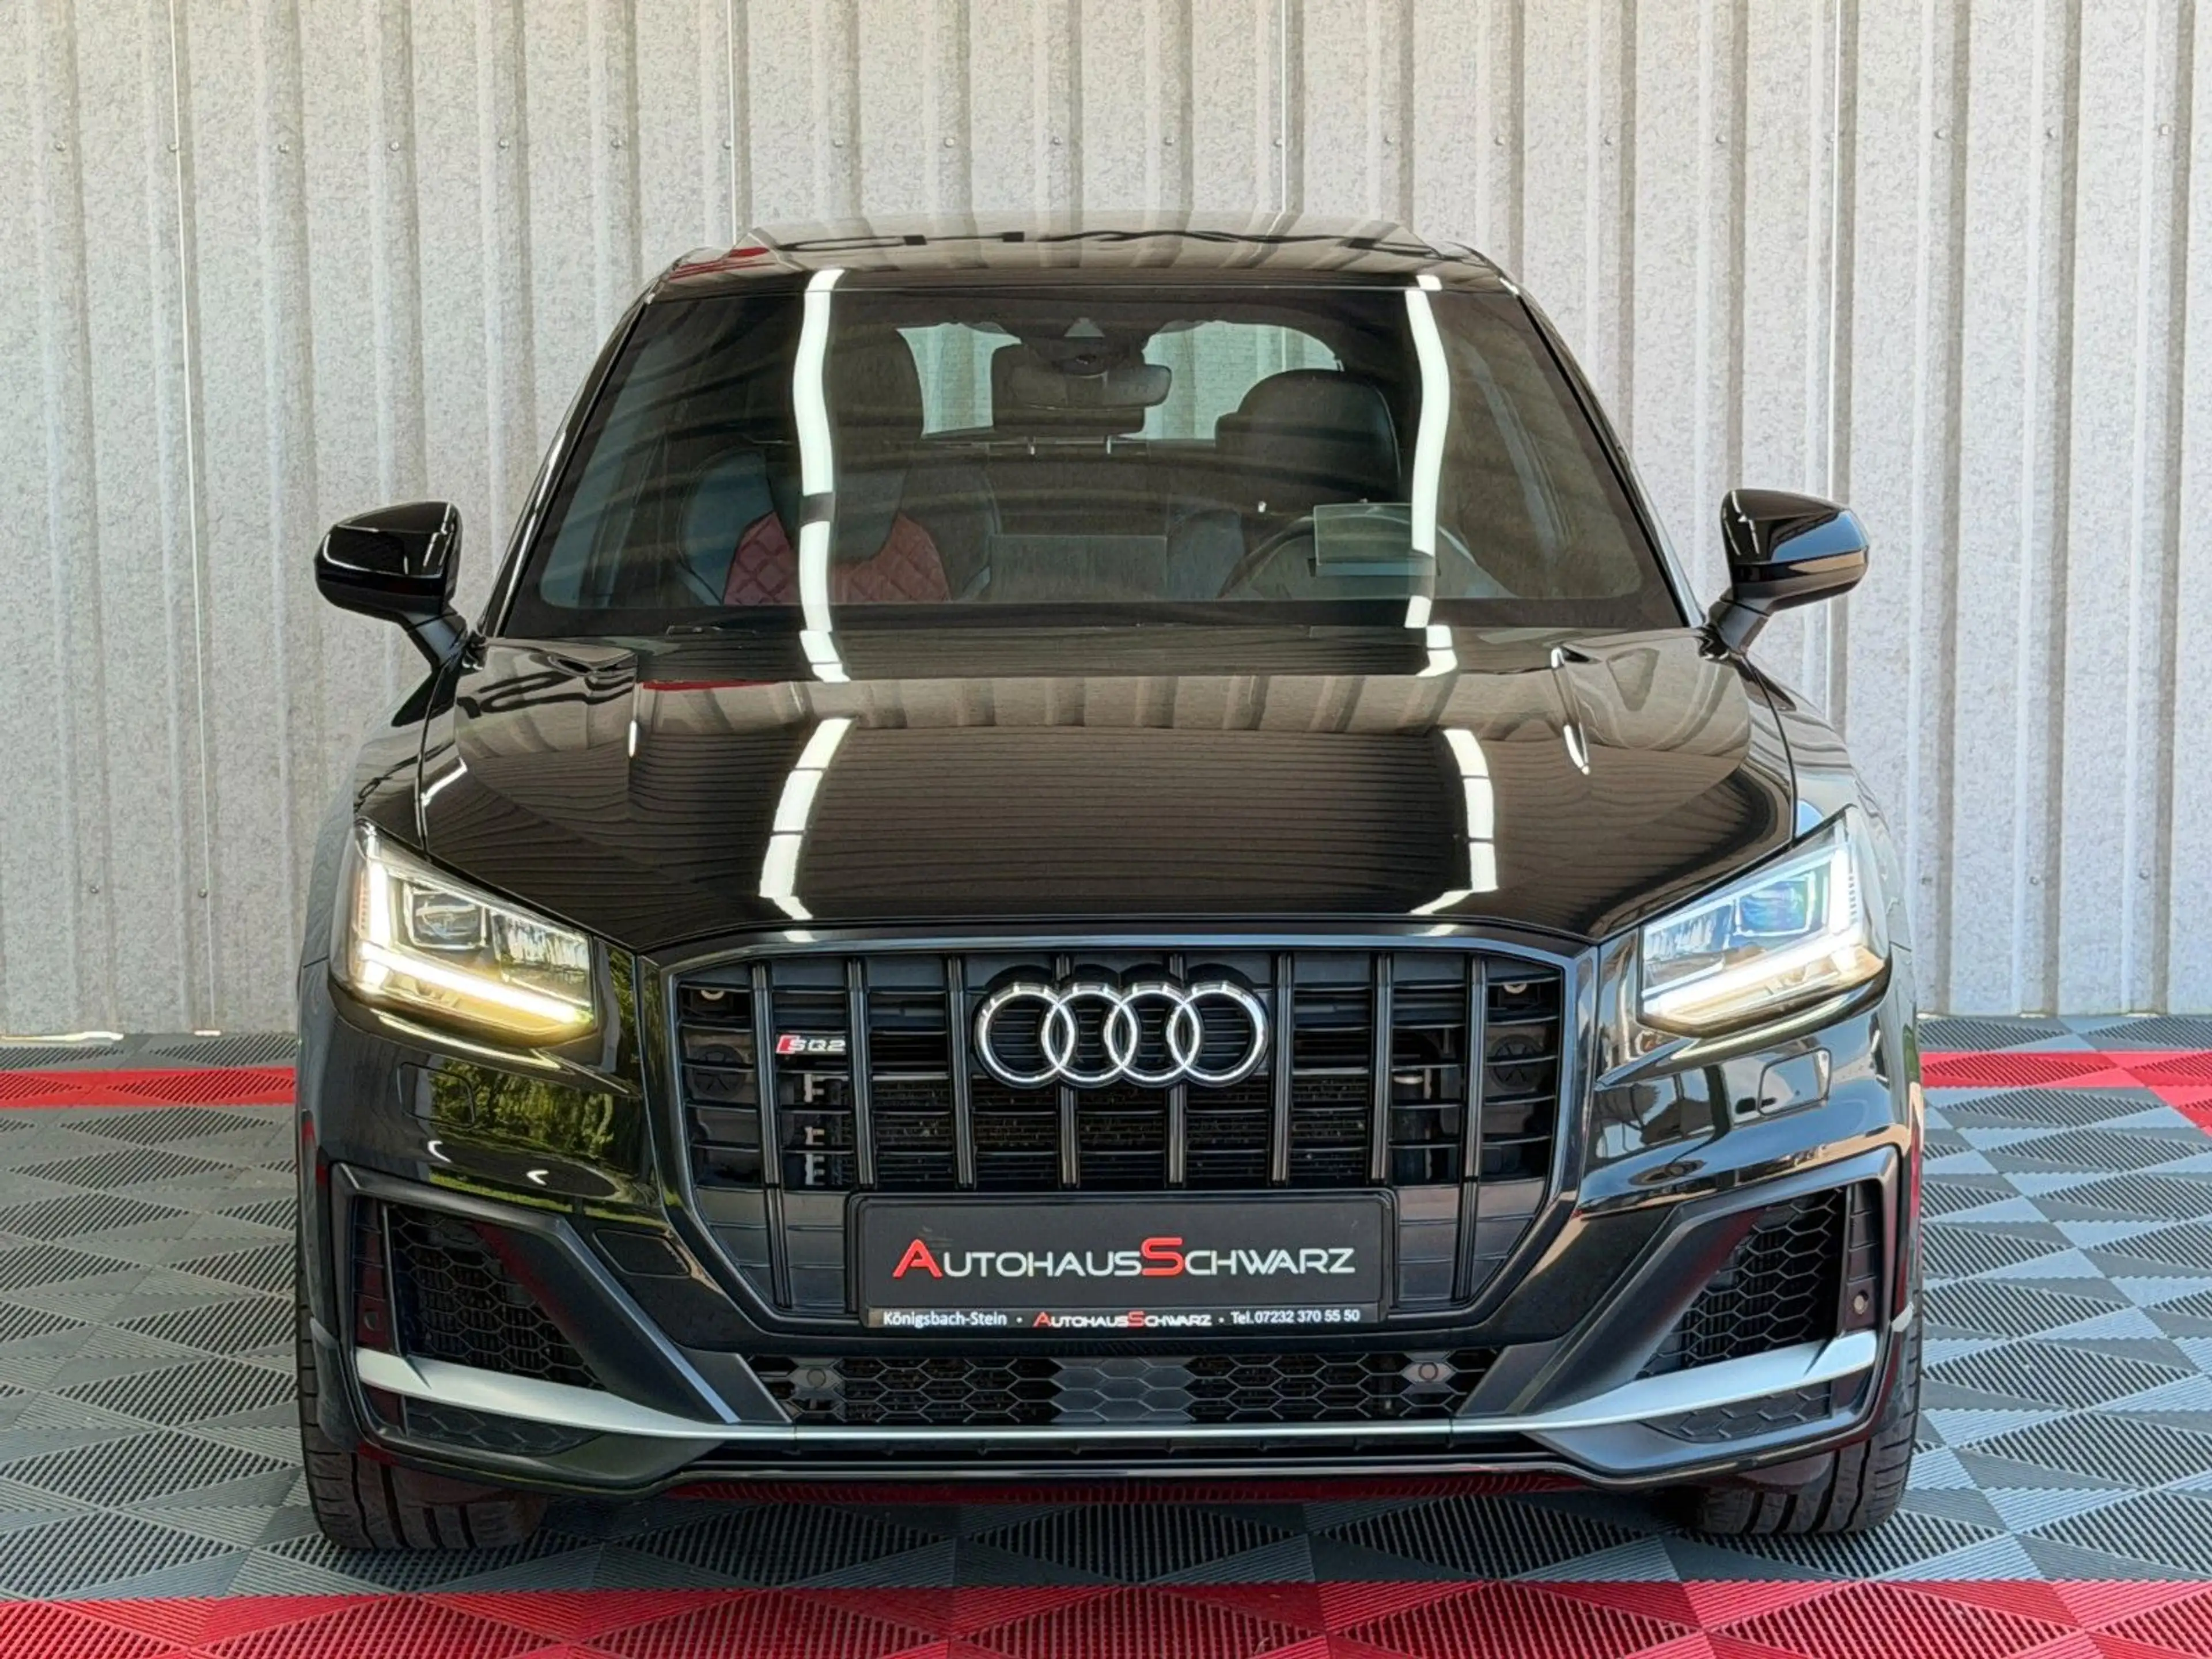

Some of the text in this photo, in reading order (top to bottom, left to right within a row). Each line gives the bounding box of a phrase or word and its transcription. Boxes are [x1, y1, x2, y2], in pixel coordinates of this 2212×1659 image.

[782, 1037, 846, 1053] SQ2
[883, 1311, 1007, 1329] Königsbach-Stein
[1297, 1309, 1321, 1324] 370
[1324, 1309, 1340, 1323] 55
[1343, 1309, 1361, 1323] 50
